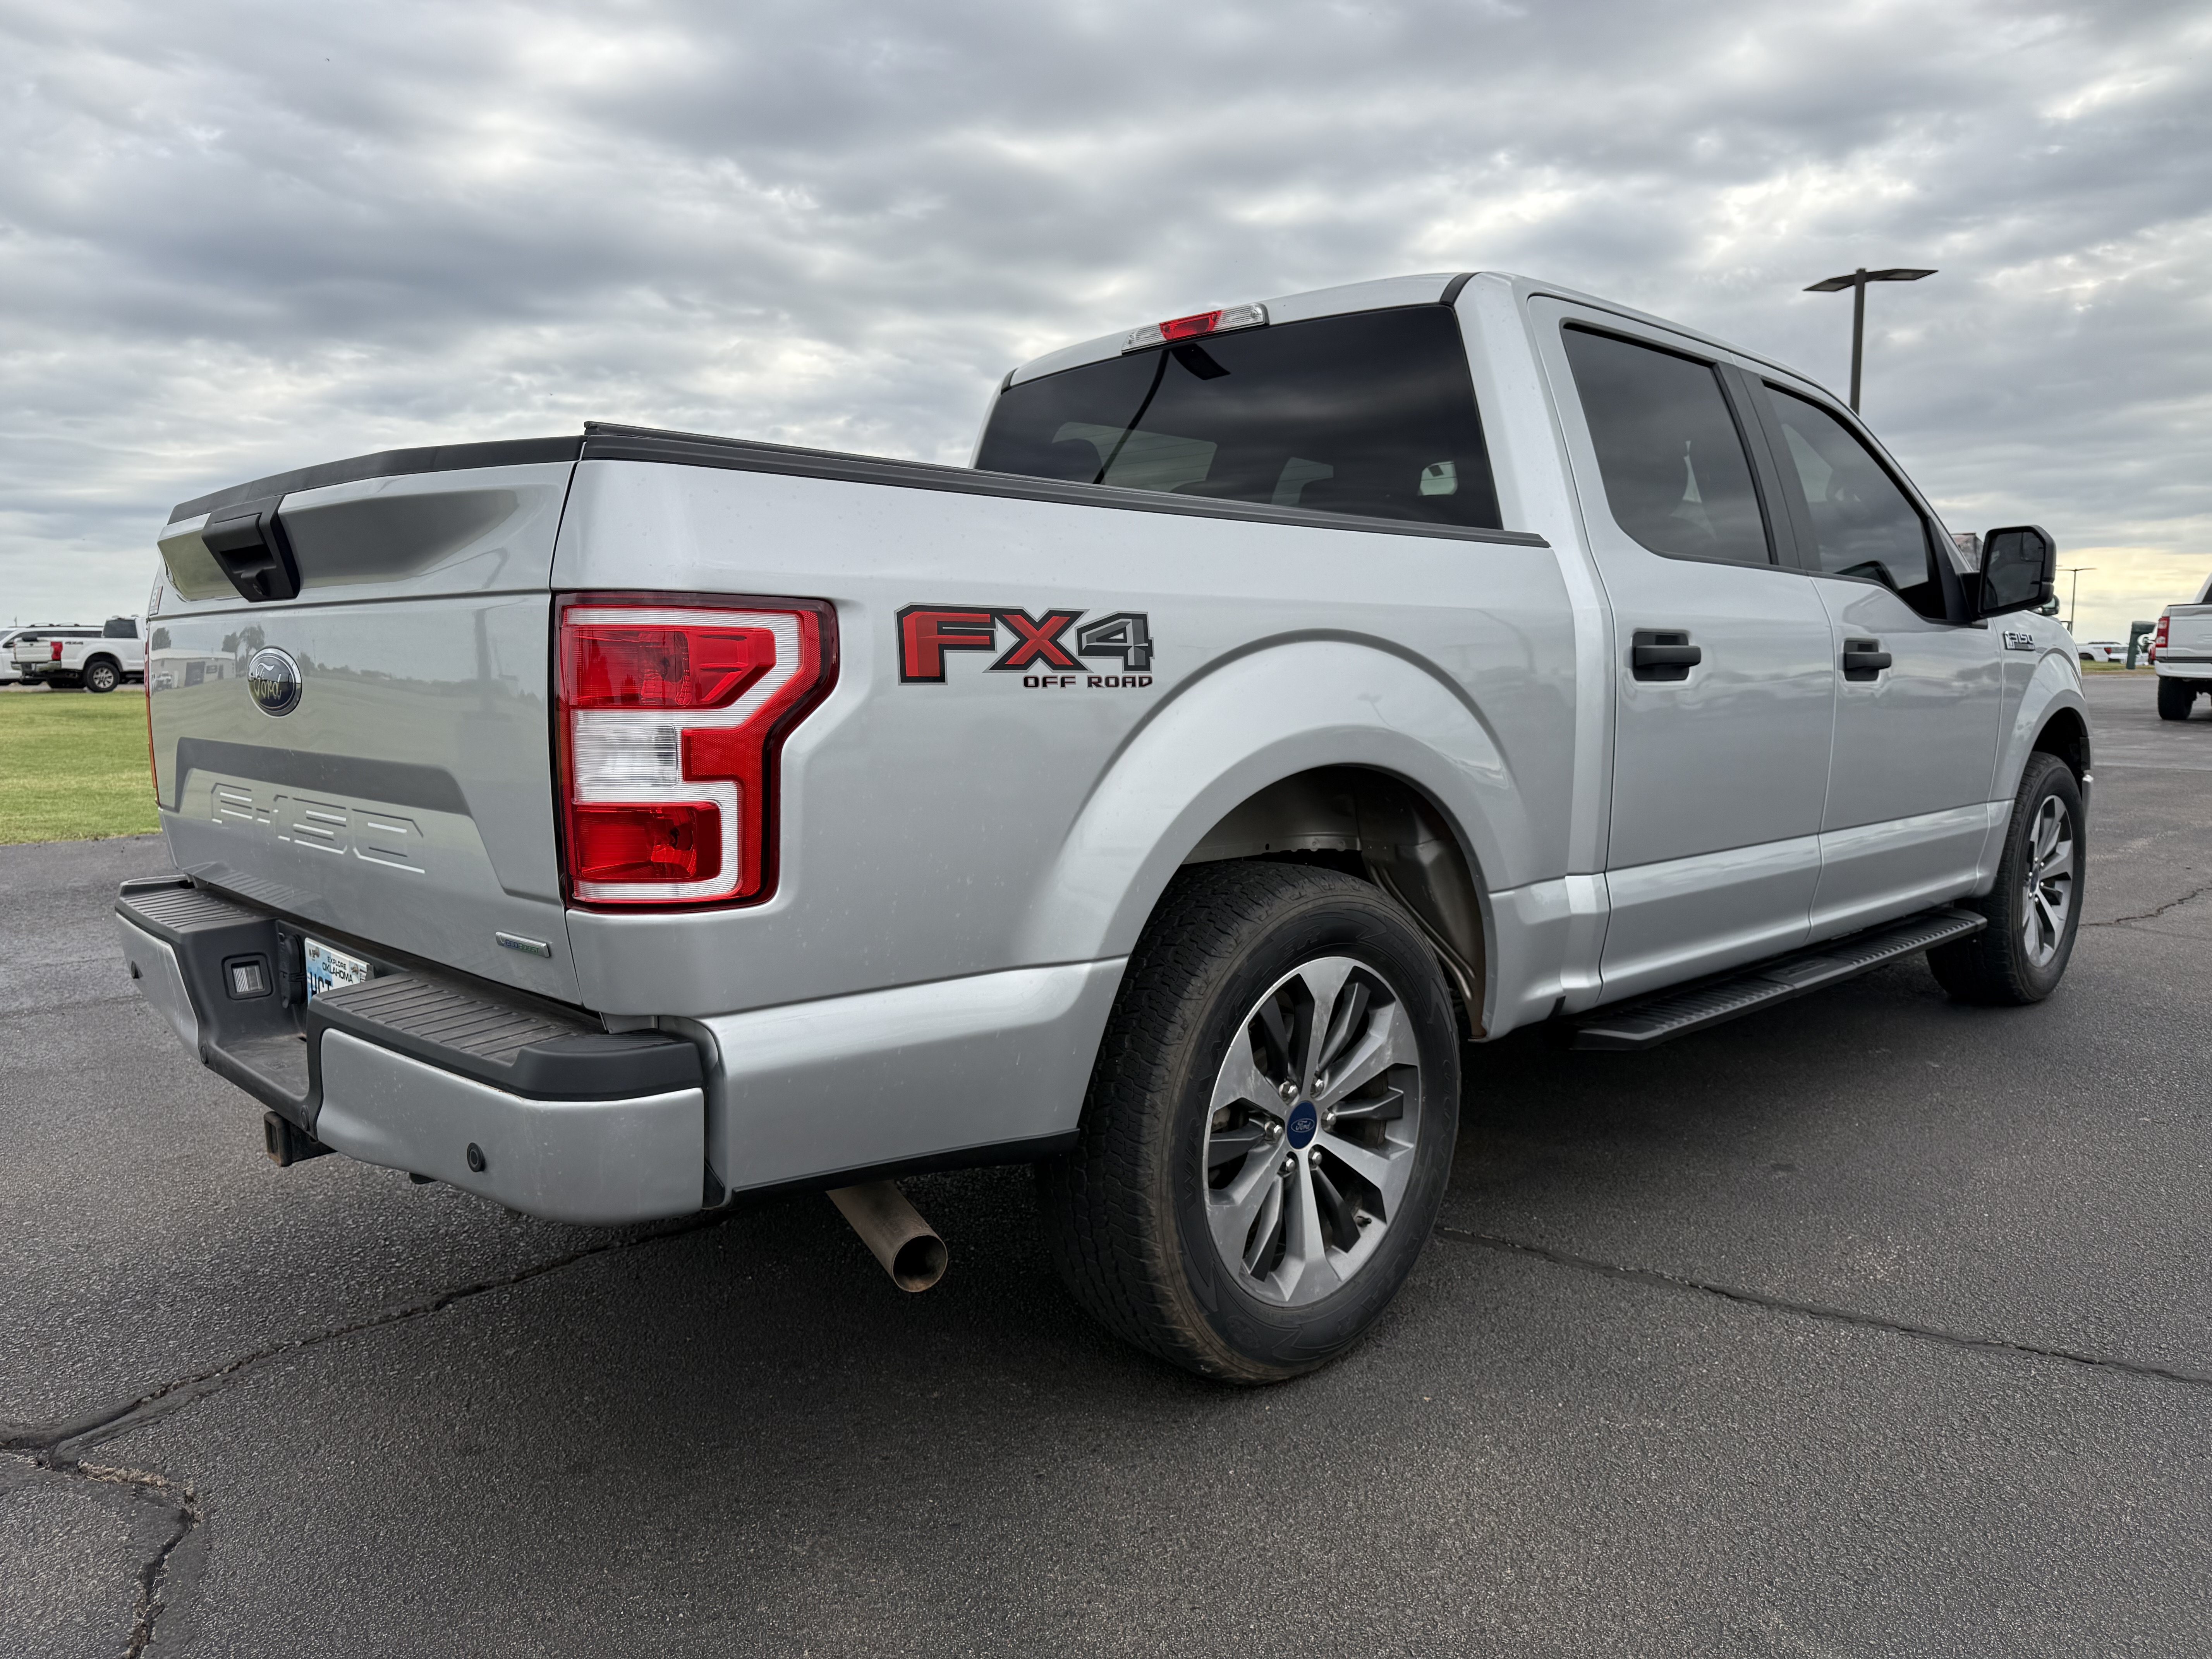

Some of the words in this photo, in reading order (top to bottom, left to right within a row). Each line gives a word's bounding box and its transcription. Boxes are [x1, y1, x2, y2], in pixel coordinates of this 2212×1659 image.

[894, 602, 1154, 686] FX4
[254, 663, 282, 700] Ford
[1023, 675, 1077, 689] OFF
[1087, 675, 1153, 689] ROAD
[211, 782, 425, 874] F-150
[322, 962, 354, 984] OKLAHOMA
[327, 956, 347, 970] EXPLORE
[1295, 1120, 1310, 1130] Ford
